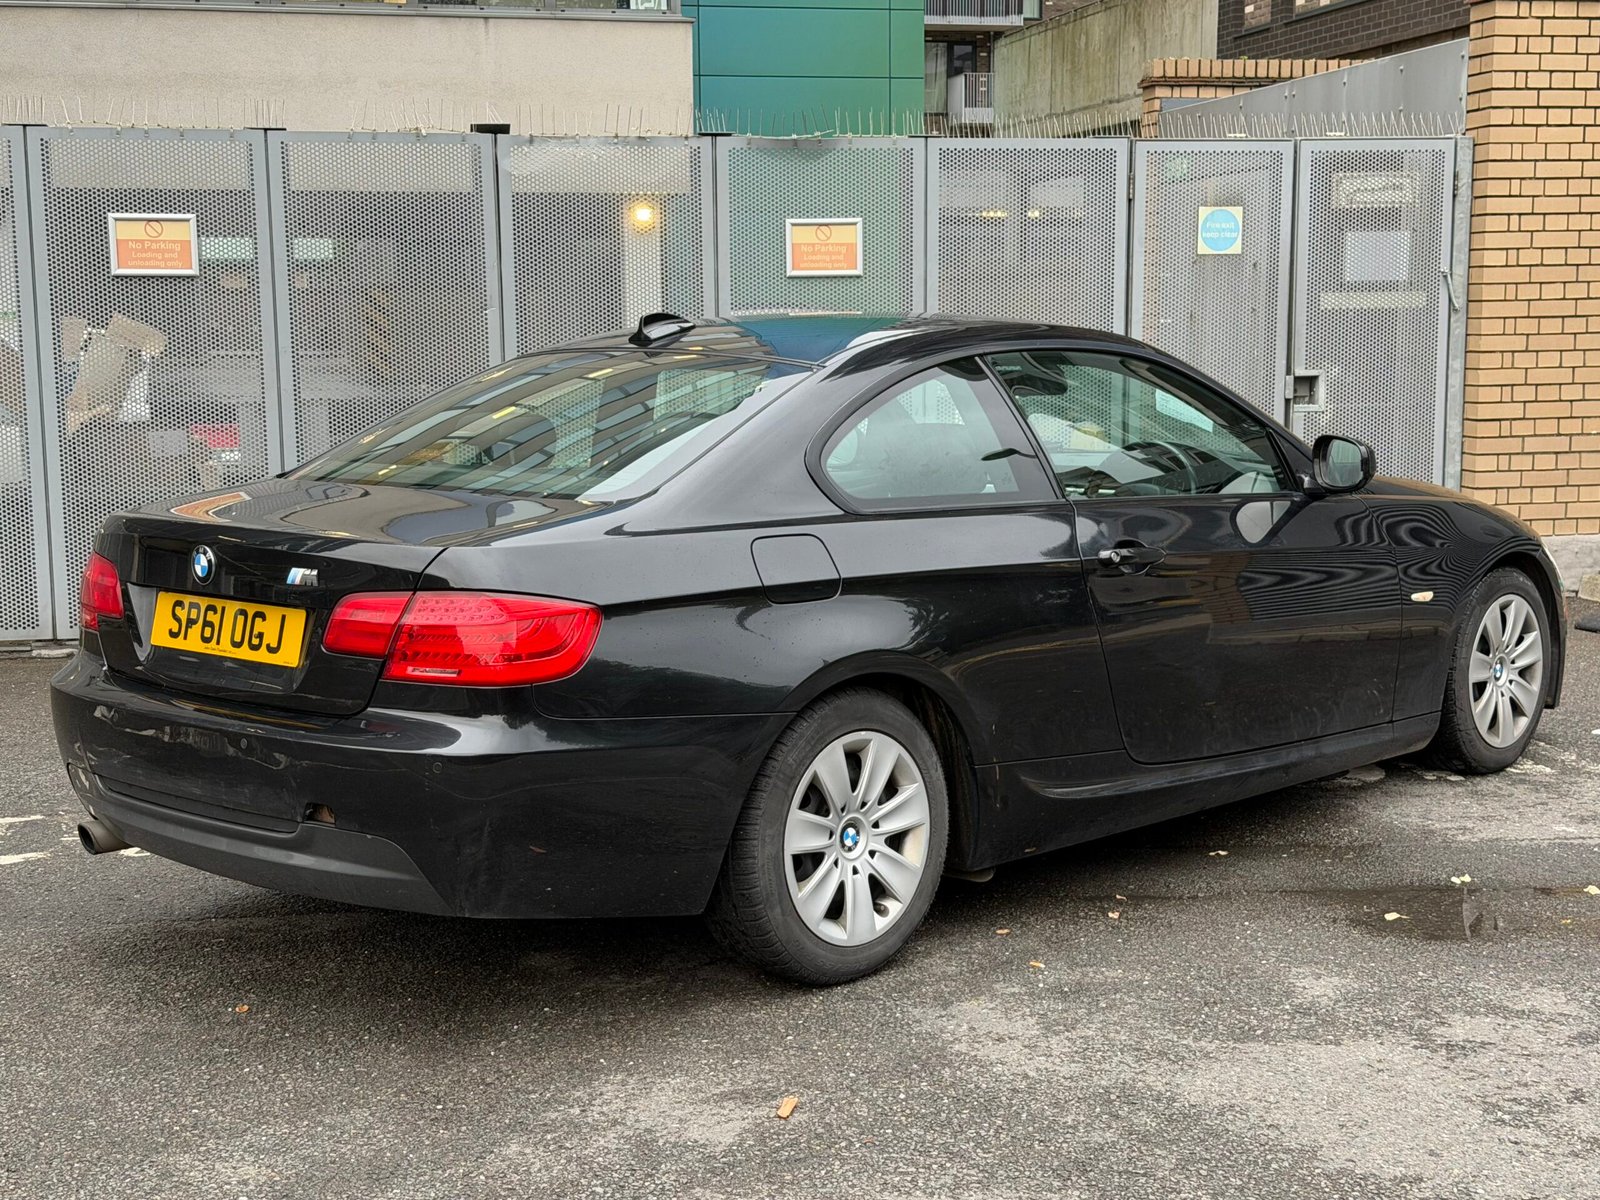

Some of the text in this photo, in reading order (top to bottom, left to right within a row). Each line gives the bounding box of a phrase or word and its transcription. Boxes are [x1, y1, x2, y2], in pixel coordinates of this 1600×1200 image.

[128, 240, 181, 251] No Parking
[801, 244, 847, 253] No Parking
[132, 251, 162, 259] Loading
[128, 259, 165, 267] unloading
[168, 599, 287, 654] SP61 OGJ
